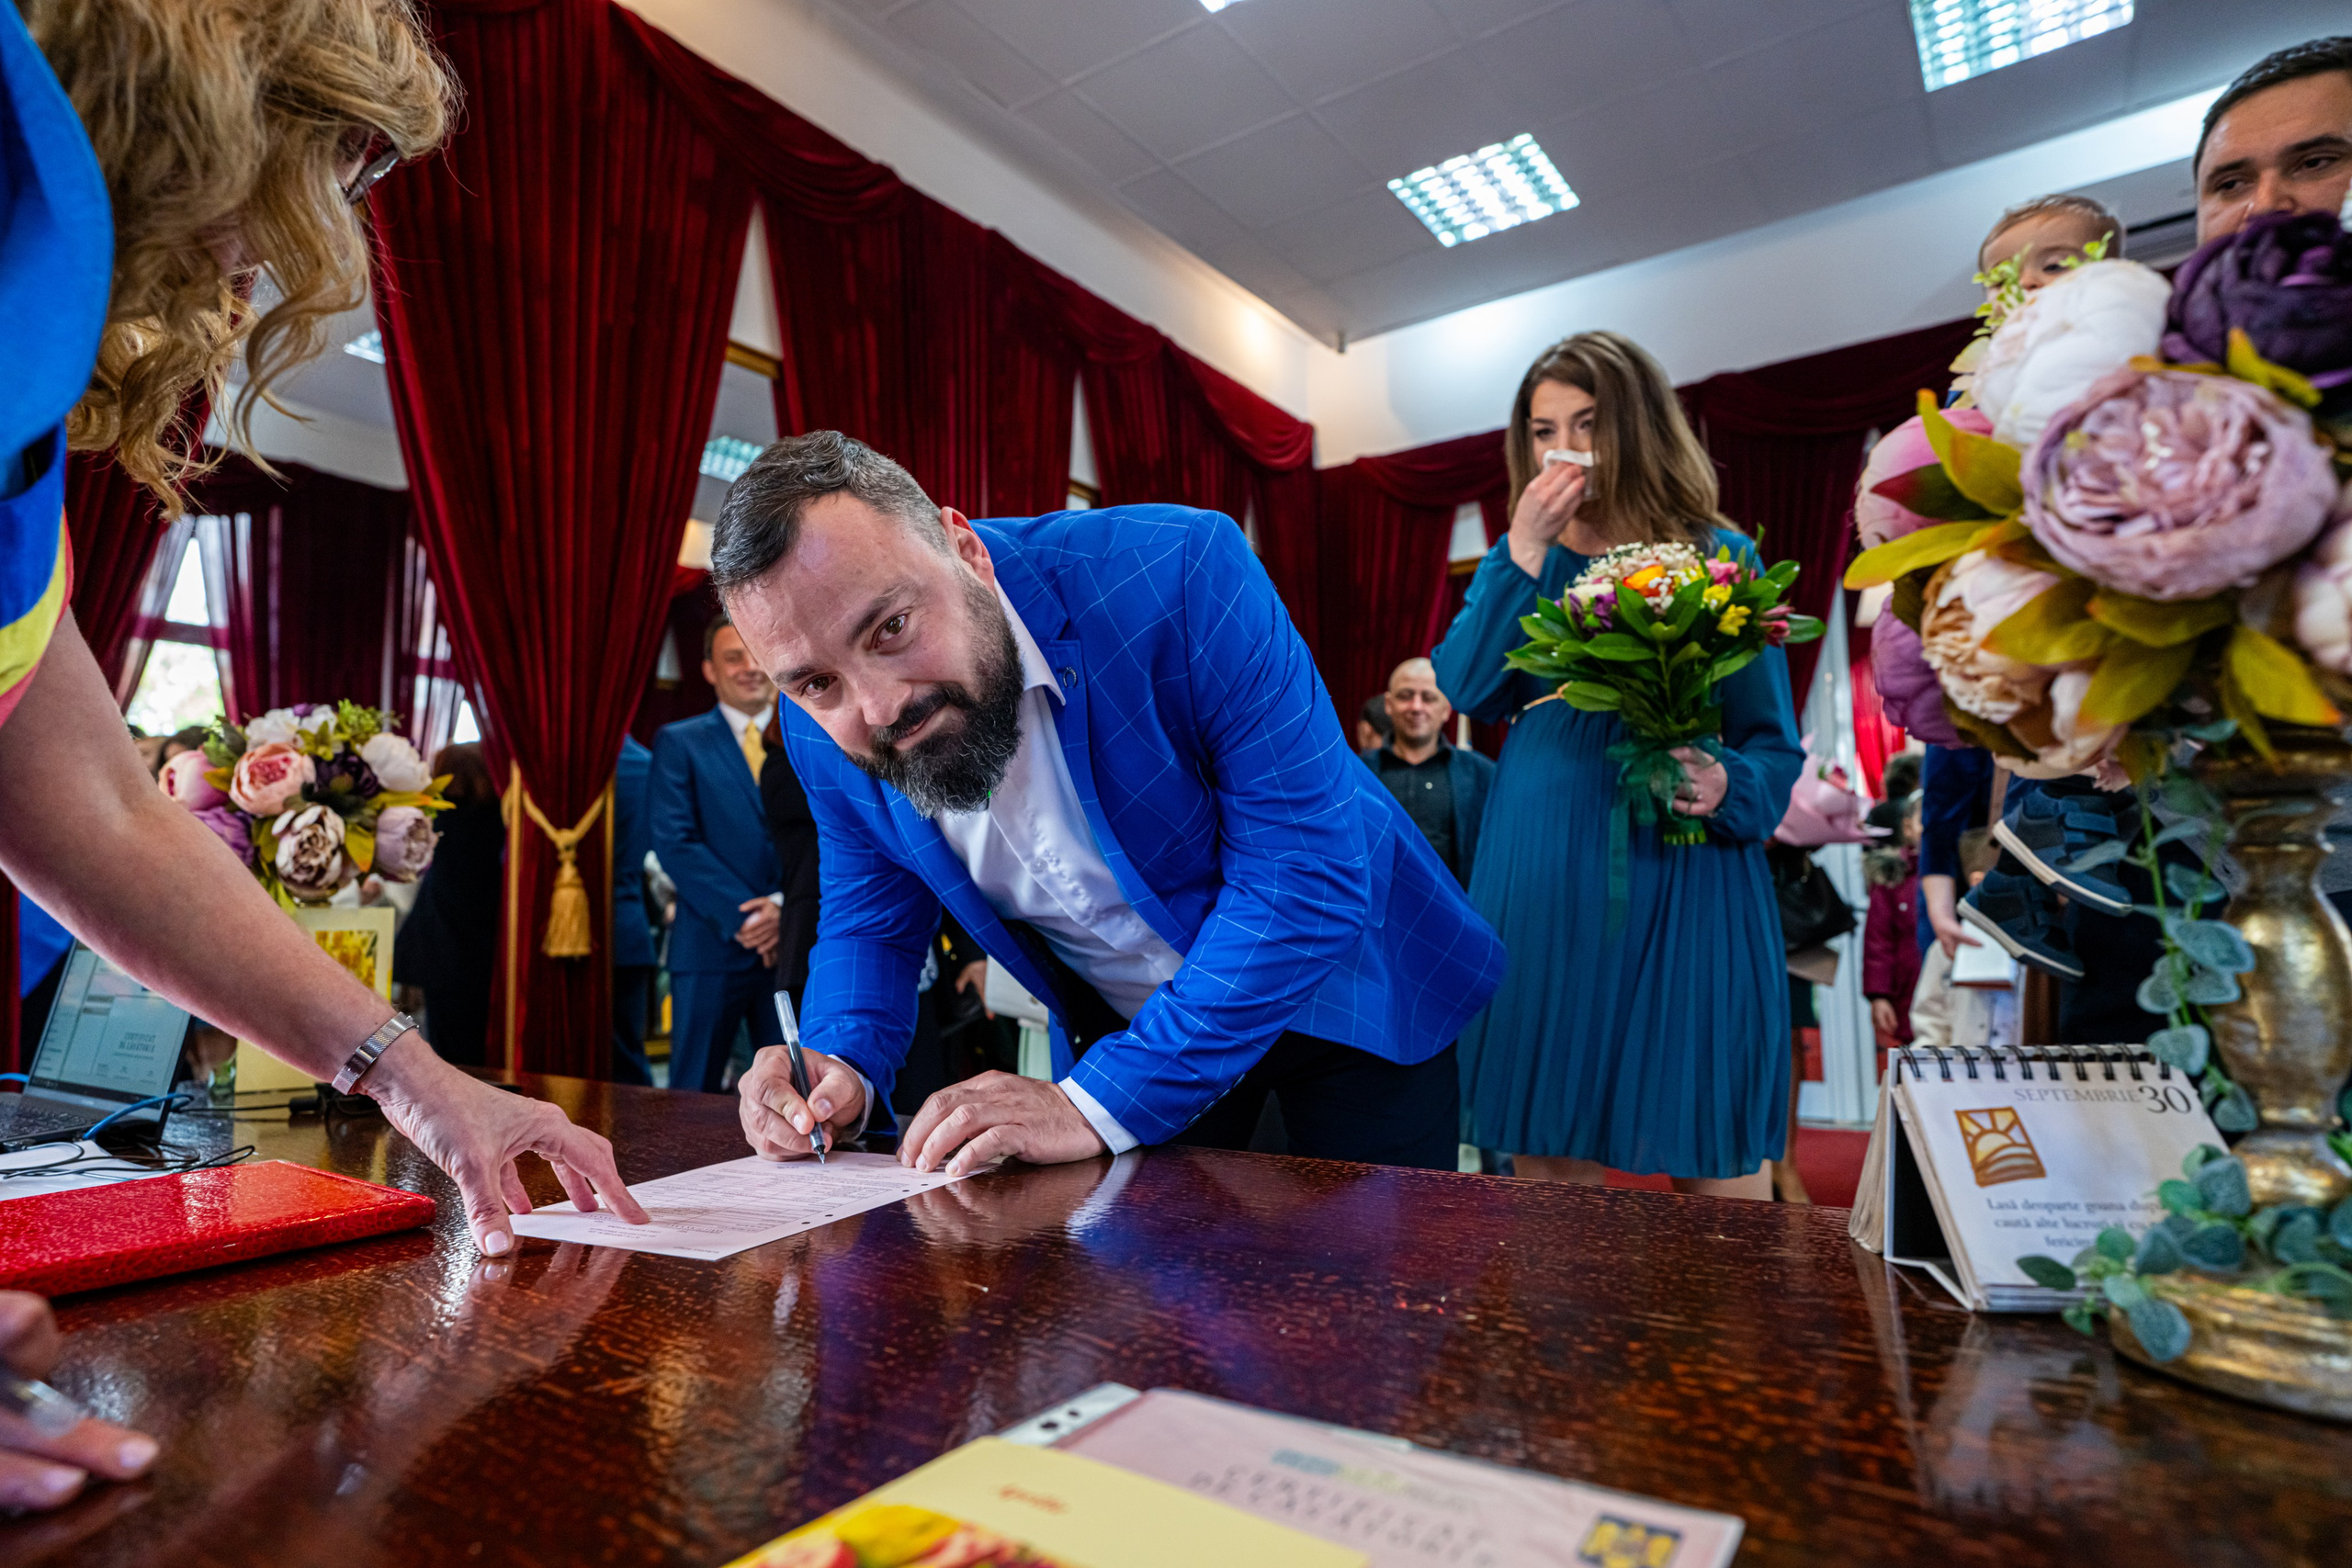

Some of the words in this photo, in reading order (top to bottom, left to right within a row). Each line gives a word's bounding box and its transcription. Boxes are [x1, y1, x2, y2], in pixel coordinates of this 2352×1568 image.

[2014, 1088, 2139, 1102] SEPTEMBRIE
[2138, 1085, 2192, 1114] 30
[2020, 1198, 2079, 1214] deoparte
[2033, 1215, 2059, 1229] alte
